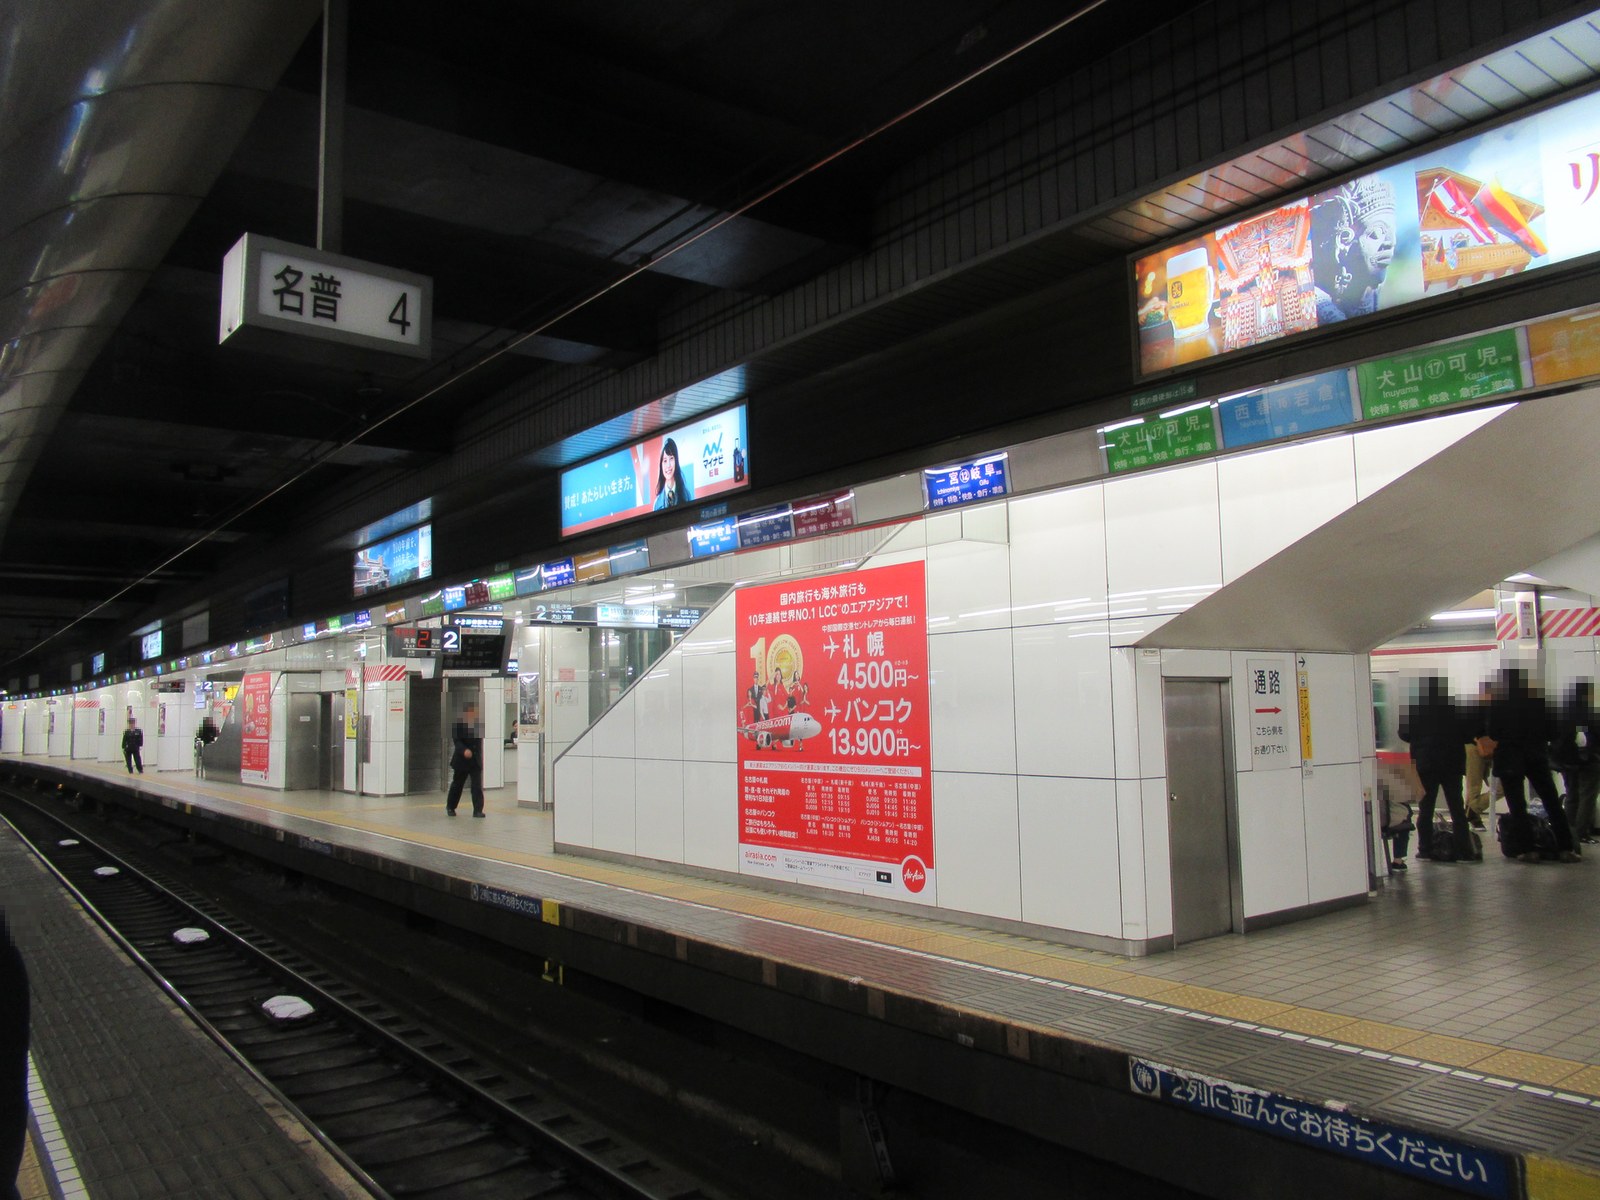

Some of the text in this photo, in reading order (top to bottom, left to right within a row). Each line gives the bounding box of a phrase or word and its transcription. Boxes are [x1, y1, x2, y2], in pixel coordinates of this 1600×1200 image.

[273, 265, 411, 335] 名普 4
[1376, 364, 1423, 389] 犬山
[1448, 347, 1498, 372] 可児
[1382, 370, 1485, 399] Inuyama Kani
[1118, 428, 1149, 447] 犬山
[703, 454, 724, 469] マイナビ
[936, 471, 959, 485] 一宮
[970, 463, 995, 480] 岐阜
[780, 582, 866, 606] 国内旅行も海外旅行も
[536, 605, 547, 620] 2
[417, 631, 431, 648] 2
[443, 631, 459, 649] 2
[843, 631, 885, 659] 札幌
[204, 681, 212, 690] 2
[1254, 670, 1280, 695] 通路
[844, 697, 912, 723] バンコク
[1256, 726, 1283, 736] こちら側を
[1254, 744, 1288, 755] お通り下さい
[745, 850, 777, 862] airasia.com
[1171, 1078, 1488, 1184] 2列に並んでお待ちください
